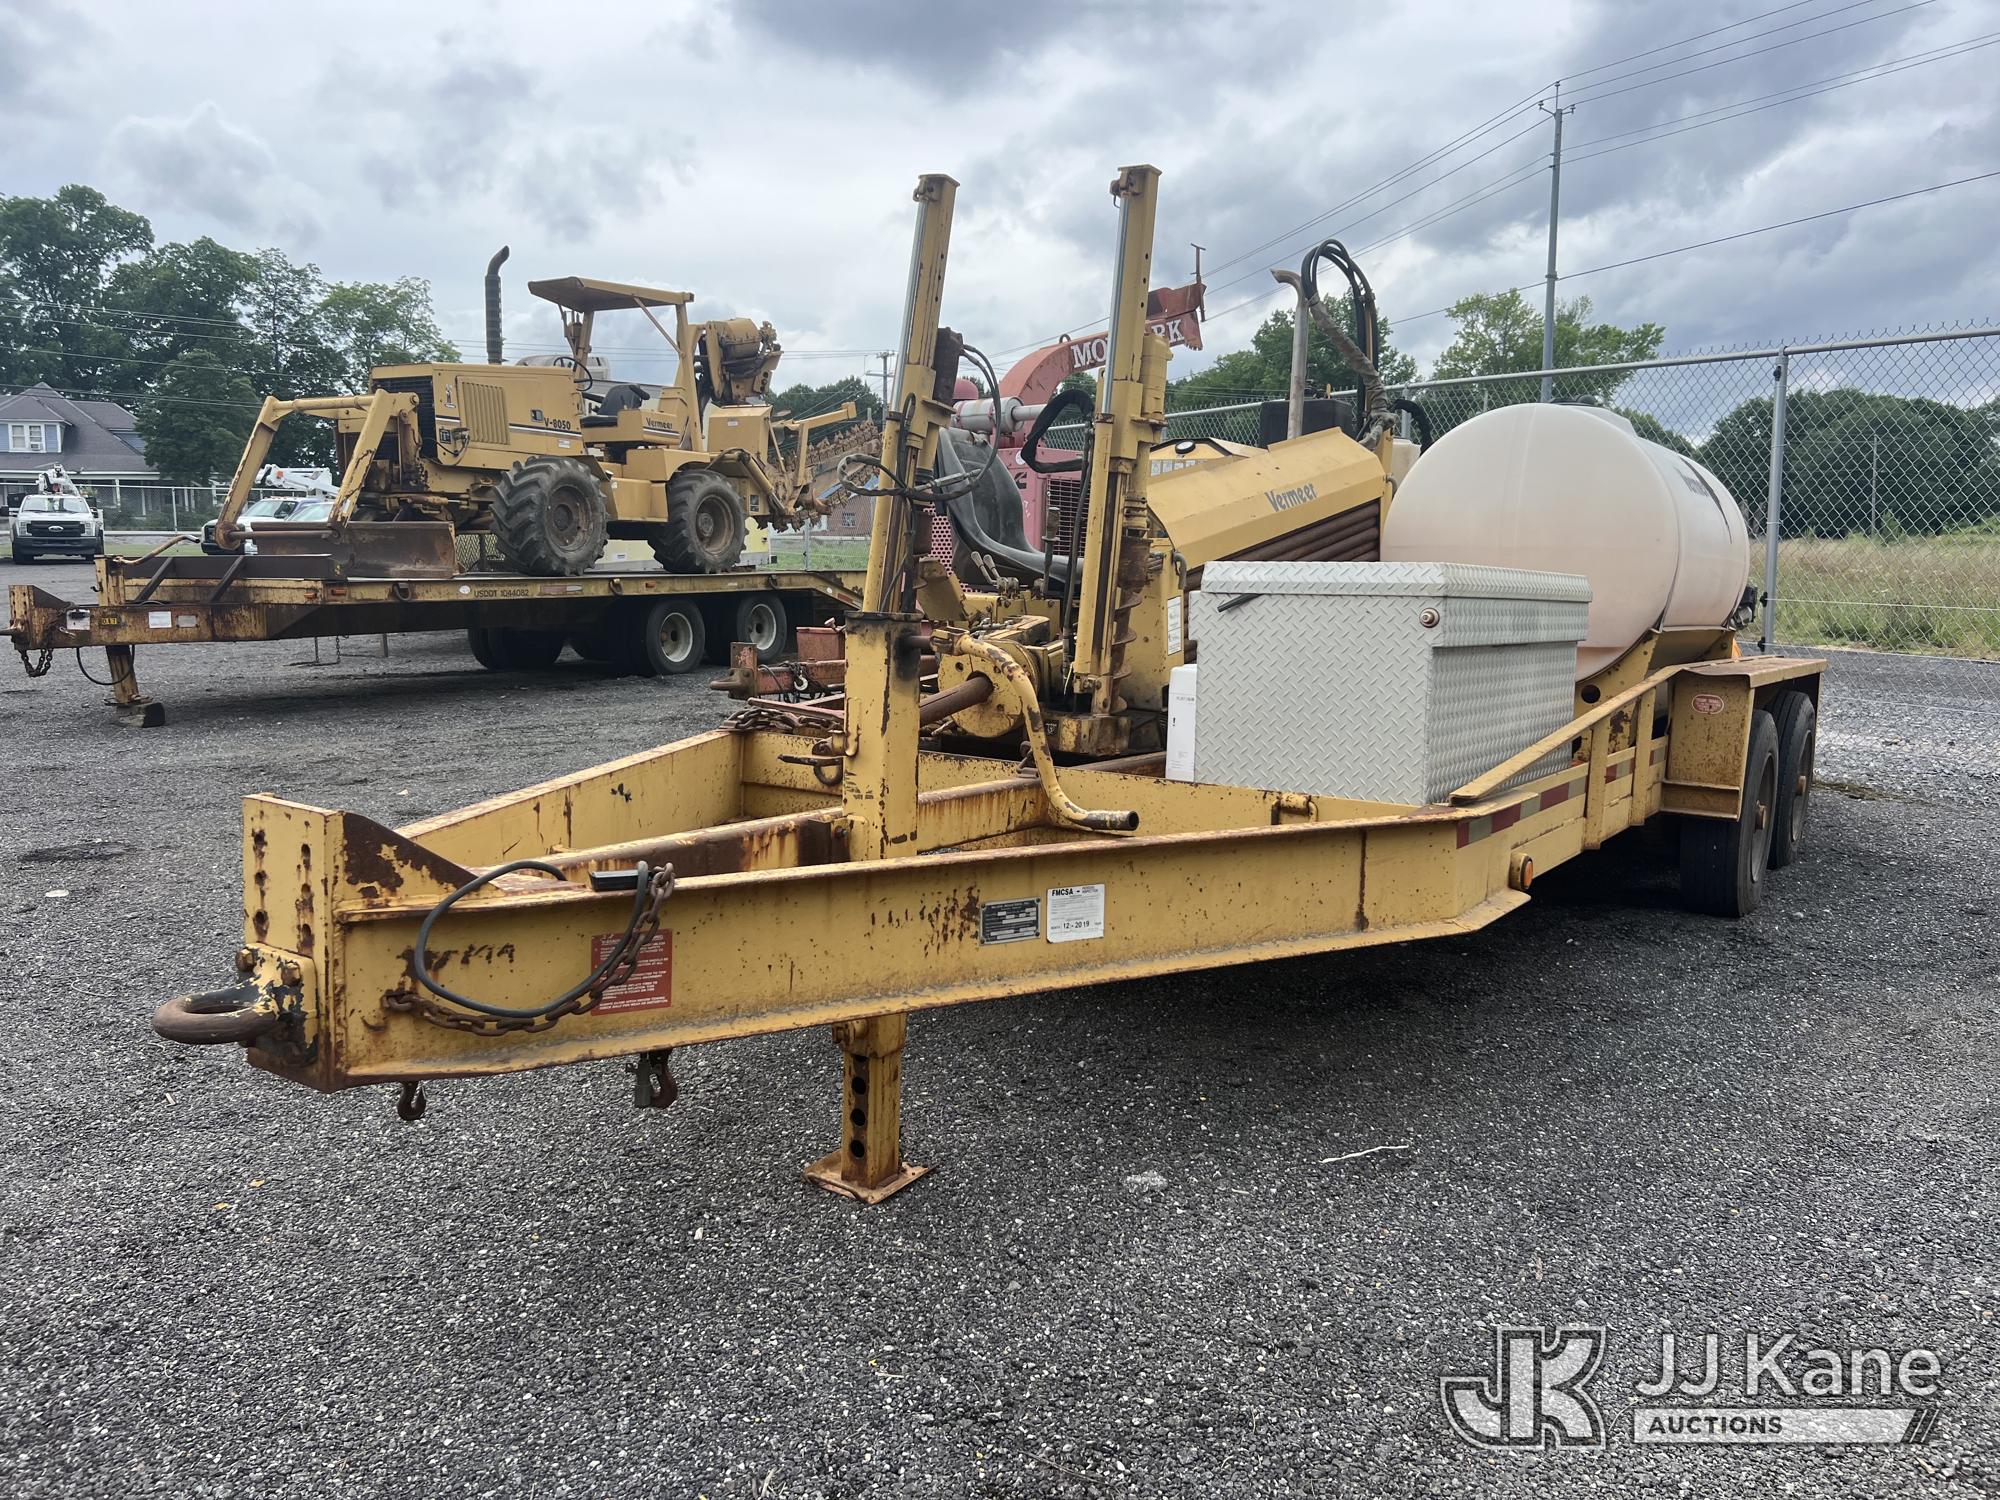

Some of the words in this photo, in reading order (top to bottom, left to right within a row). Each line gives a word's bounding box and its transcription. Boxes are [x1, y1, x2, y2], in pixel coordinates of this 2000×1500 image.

[1071, 319, 1185, 368] MORK
[543, 417, 571, 430] V-8050
[645, 417, 673, 429] Vermeer
[1264, 483, 1317, 512] Vermeer
[474, 589, 498, 598] USDOT
[1051, 888, 1074, 897] FMCSA
